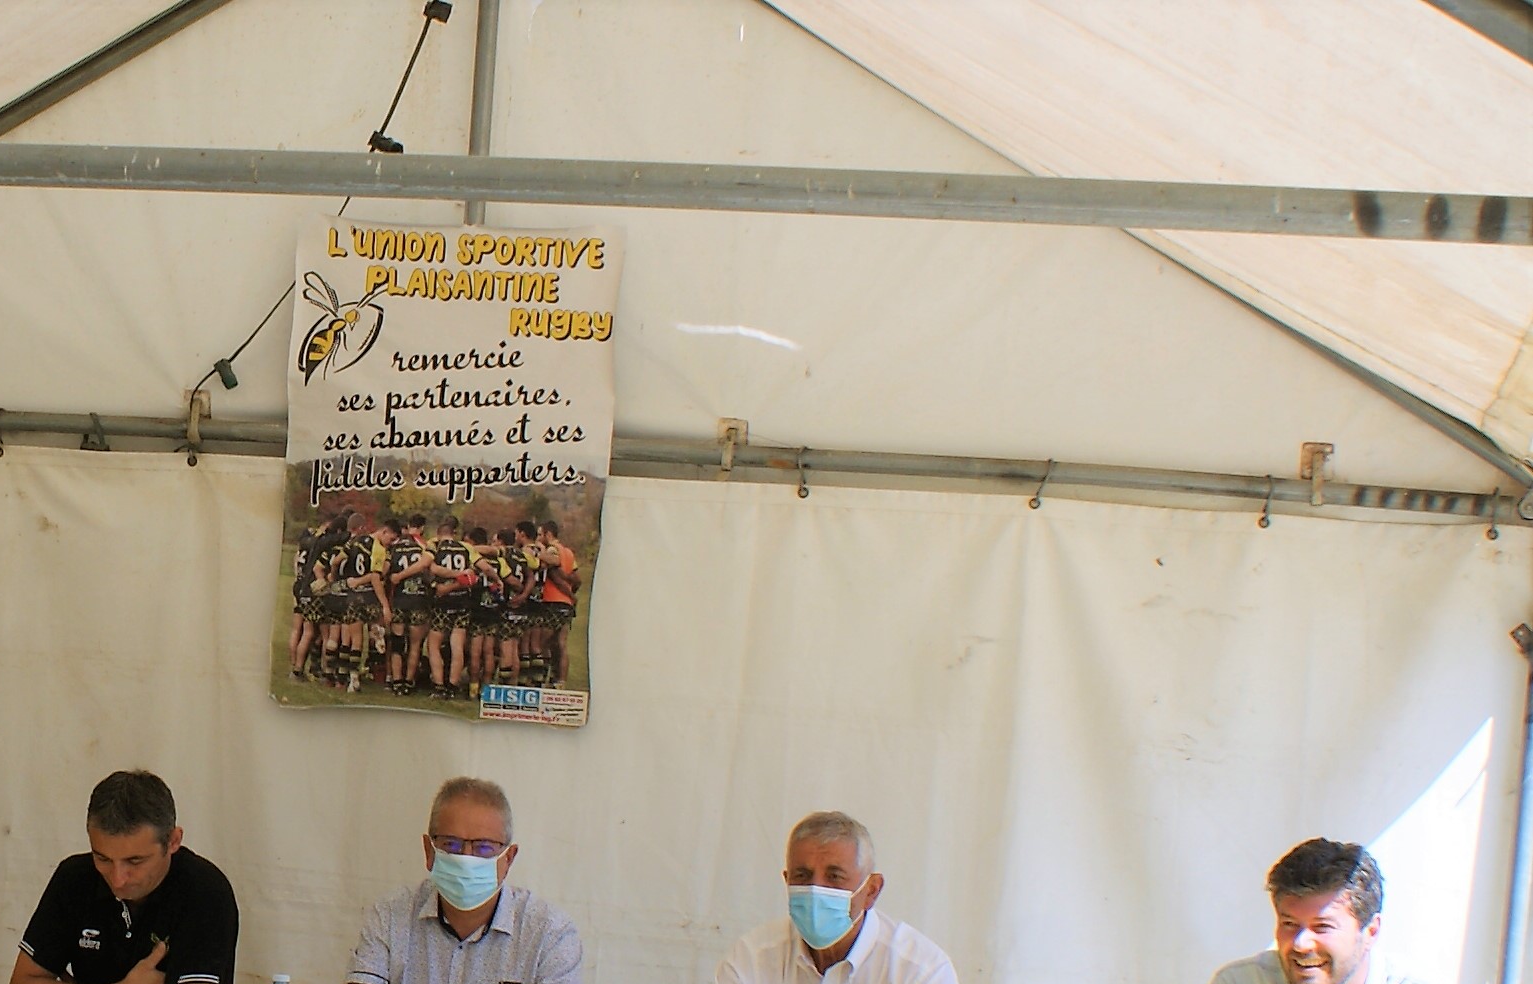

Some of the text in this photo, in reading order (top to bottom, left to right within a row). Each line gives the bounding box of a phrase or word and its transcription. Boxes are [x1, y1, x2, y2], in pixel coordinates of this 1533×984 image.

[327, 227, 606, 269] L'UNION SPORTIVE
[365, 265, 559, 303] PLAISANTINE
[509, 307, 614, 341] RUGBY
[391, 341, 525, 371] remercie
[337, 394, 376, 412] ses
[323, 413, 586, 451] ses abonnés et ses
[310, 452, 586, 506] fidèles supporters.
